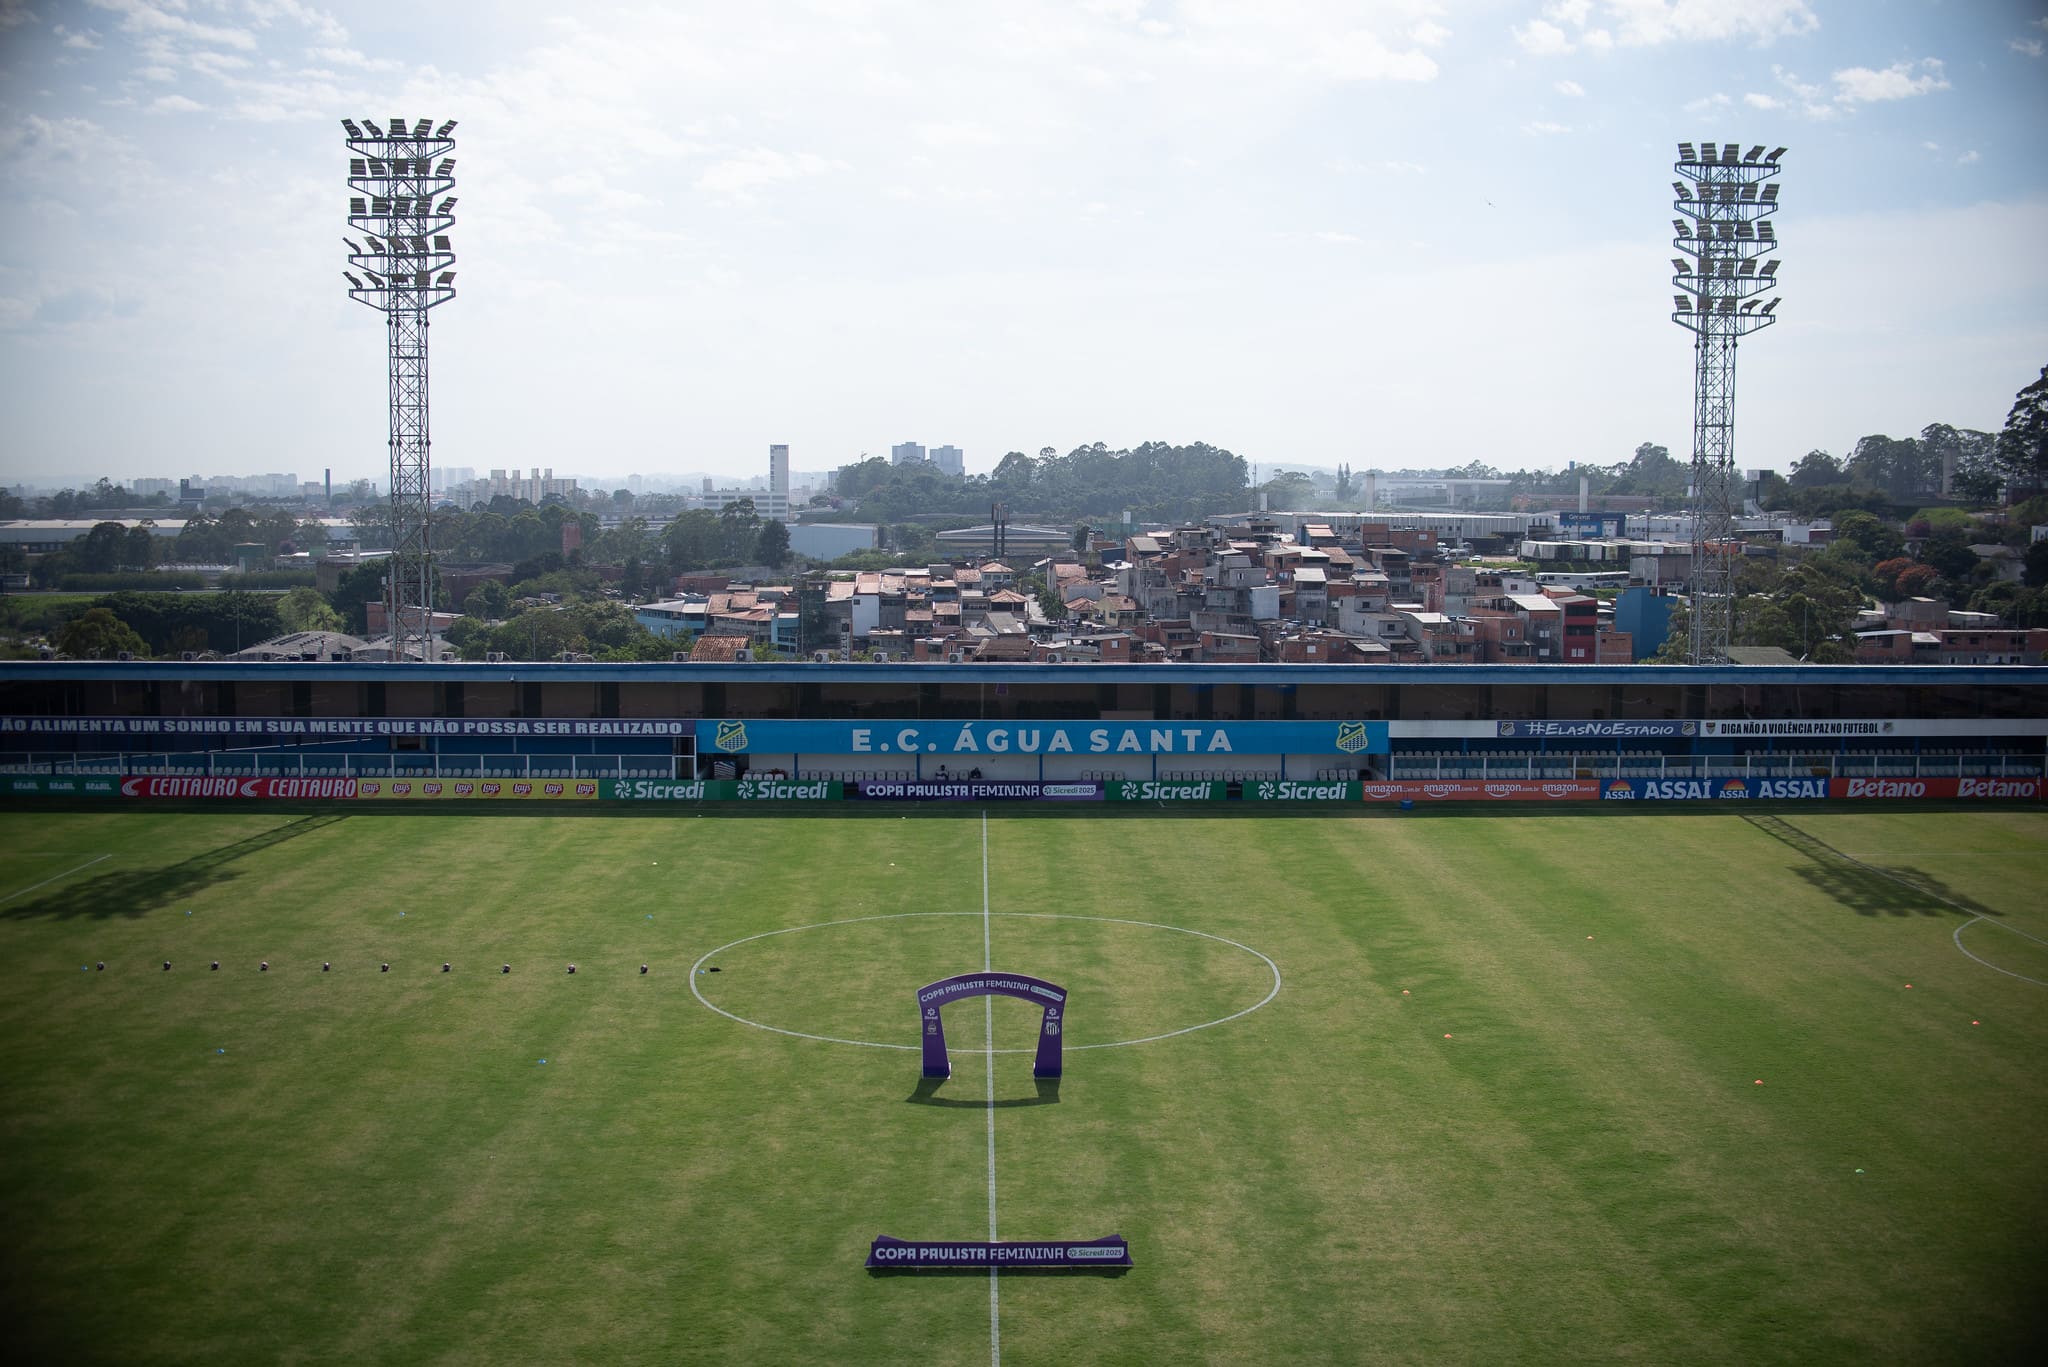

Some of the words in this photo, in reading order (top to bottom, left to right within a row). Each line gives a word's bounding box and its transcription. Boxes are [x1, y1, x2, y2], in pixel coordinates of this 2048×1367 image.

[30, 720, 126, 732] ALIMENTA
[129, 720, 160, 732] UM
[164, 720, 231, 732] SONHO
[235, 721, 262, 732] EM
[266, 721, 306, 733] SUA
[309, 721, 374, 733] MENTE
[377, 722, 416, 735] QUE
[420, 719, 459, 733] NÃO
[464, 722, 529, 734] POSSA
[533, 722, 570, 734] SER
[575, 722, 682, 734] REALIZADO
[1721, 723, 1742, 734] DIGA
[1743, 721, 1761, 734] NÃO
[1762, 723, 1768, 734] A
[1768, 721, 1812, 734] VIOLÊNCIA
[1814, 723, 1829, 734] PAZ
[1830, 723, 1842, 734] NO
[1843, 723, 1879, 734] FUTEBOL
[954, 723, 1073, 752] ÁGUA
[1089, 729, 1233, 752] SANTA
[149, 778, 237, 797] CENTAURO
[268, 779, 356, 798] CENTAURO
[635, 781, 705, 799] Sicredi
[756, 781, 829, 799] Sicredi
[866, 785, 904, 797] COPA
[907, 785, 969, 797] PAULISTA
[972, 785, 1040, 797] FEMININA
[1053, 786, 1078, 794] Sicredi
[1140, 782, 1212, 800] Sicredi
[1277, 782, 1347, 800] Sicredi
[1644, 780, 1712, 799] ASSAÍ
[1758, 779, 1825, 798] ASSAÍ
[1846, 778, 1926, 798] Betano
[1957, 778, 2035, 798] Betano
[921, 988, 945, 1003] COPA
[946, 980, 985, 994] PAULISTA
[986, 980, 1030, 992] FEMININA
[875, 1247, 916, 1260] COPA
[920, 1247, 986, 1260] PAULISTA
[990, 1247, 1063, 1260] FEMININA
[1078, 1248, 1104, 1257] Sicredi
